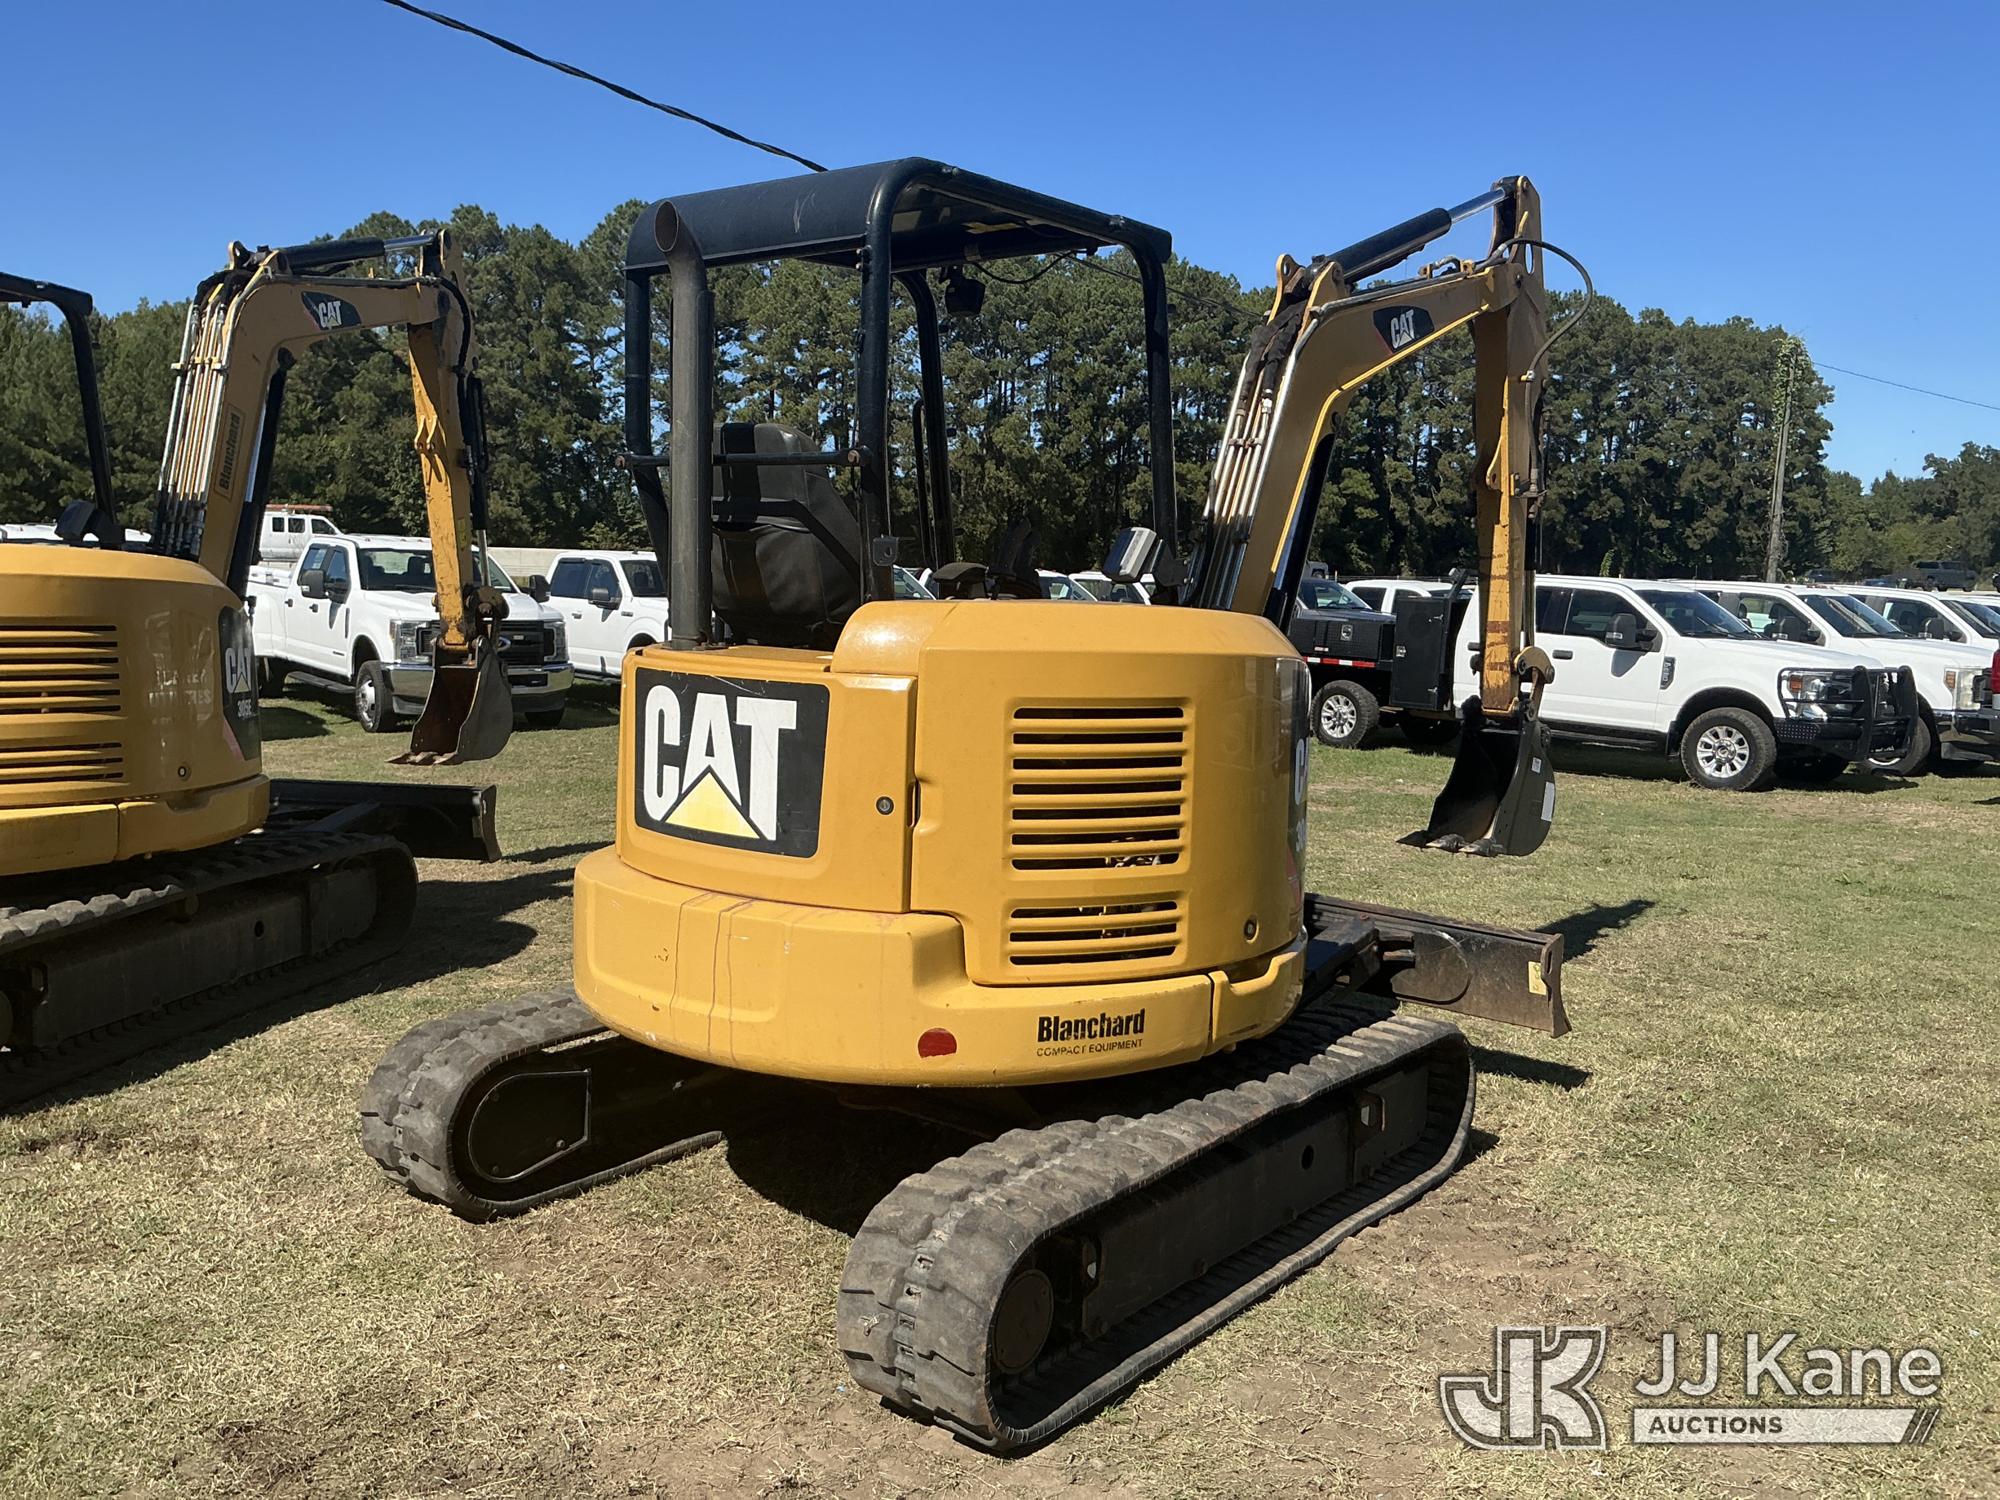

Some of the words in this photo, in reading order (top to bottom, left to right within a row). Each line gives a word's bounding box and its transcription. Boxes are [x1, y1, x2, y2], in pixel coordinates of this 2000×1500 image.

[318, 300, 342, 328] CAT
[1390, 309, 1415, 349] CAT
[225, 647, 252, 693] CAT
[643, 684, 798, 841] CAT
[1037, 1007, 1146, 1043] Blanchard
[1036, 1045, 1087, 1057] COMPACT
[1088, 1038, 1143, 1053] EQUIPMENT
